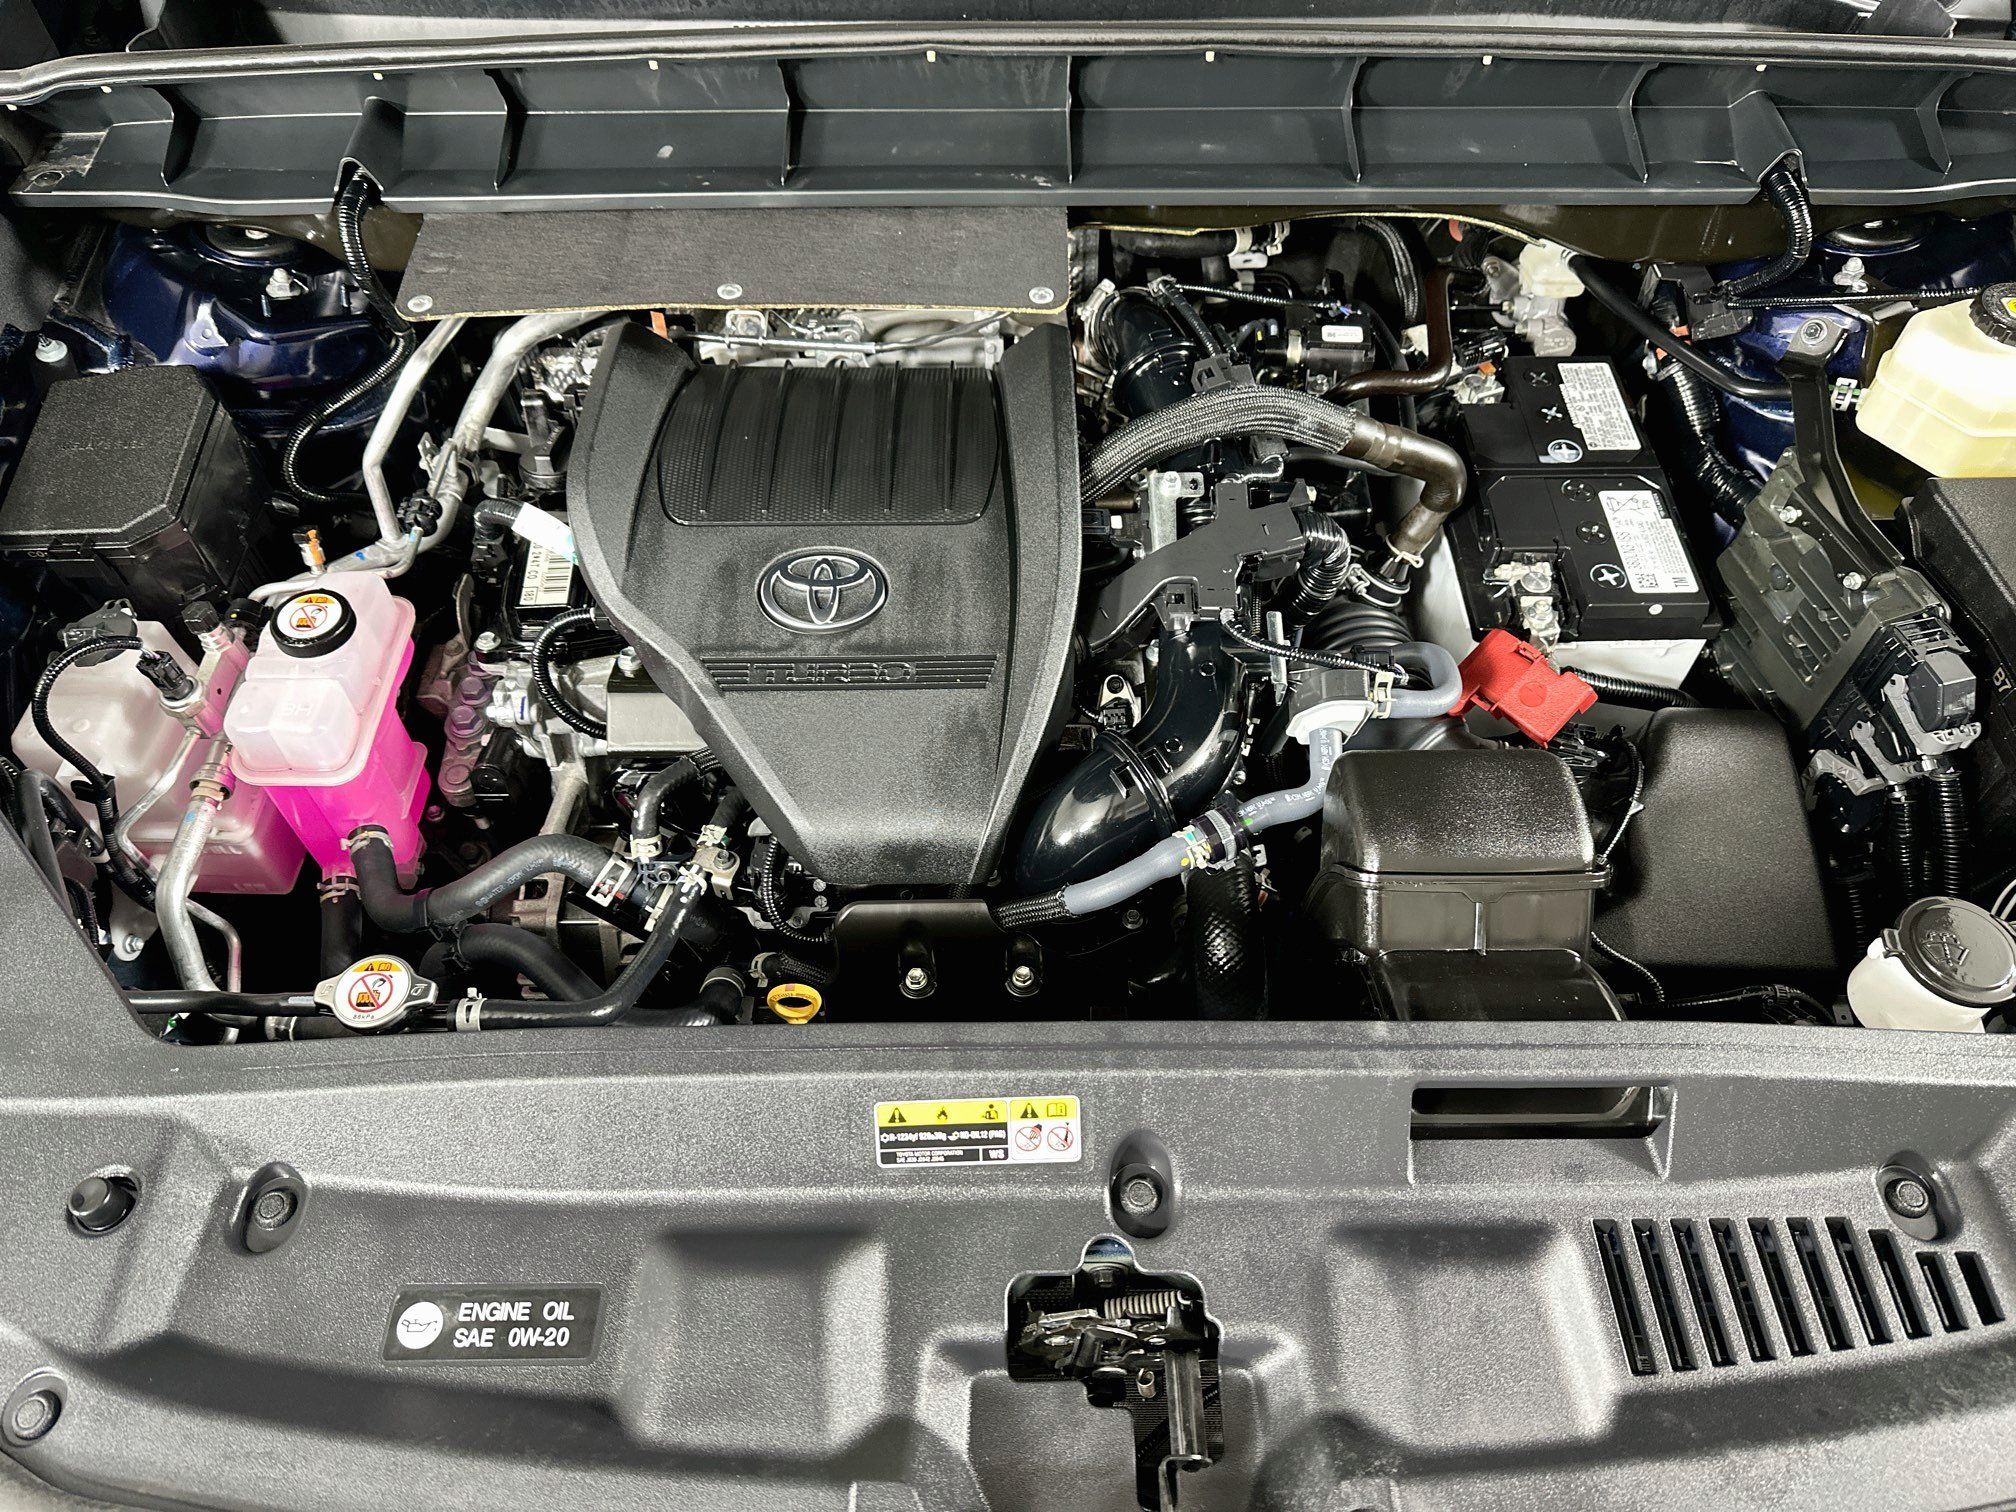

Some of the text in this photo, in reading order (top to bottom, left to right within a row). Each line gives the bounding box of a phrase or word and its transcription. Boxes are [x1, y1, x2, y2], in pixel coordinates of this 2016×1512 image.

[753, 661, 911, 684] TURBO
[988, 1148, 1005, 1160] WS
[458, 1301, 575, 1322] ENGINE OIL
[453, 1326, 571, 1348] SAE 0W-20
